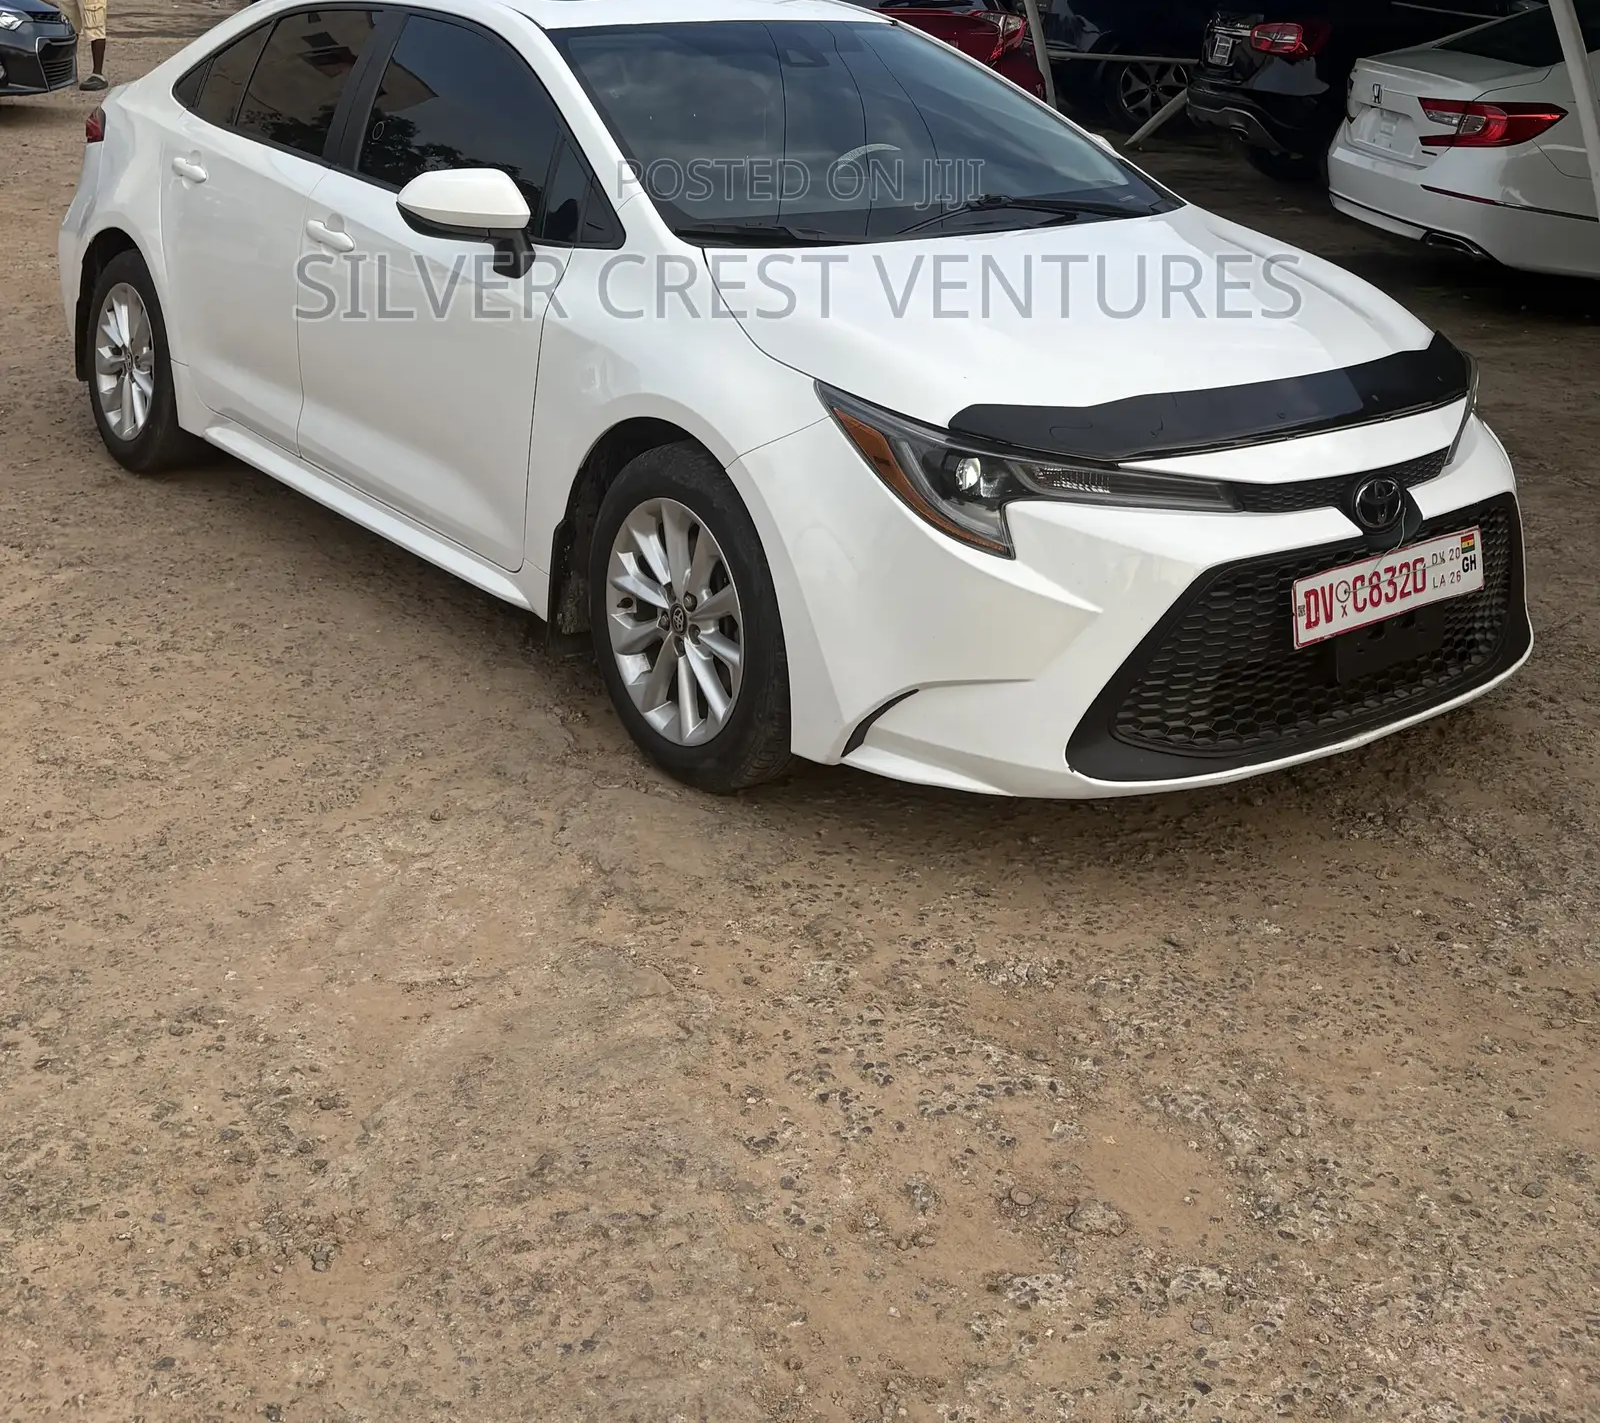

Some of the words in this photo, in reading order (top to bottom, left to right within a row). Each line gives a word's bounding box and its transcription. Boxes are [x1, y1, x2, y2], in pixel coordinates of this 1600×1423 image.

[1462, 554, 1477, 573] GH
[1432, 574, 1446, 589] LA
[1304, 582, 1334, 630] DV
